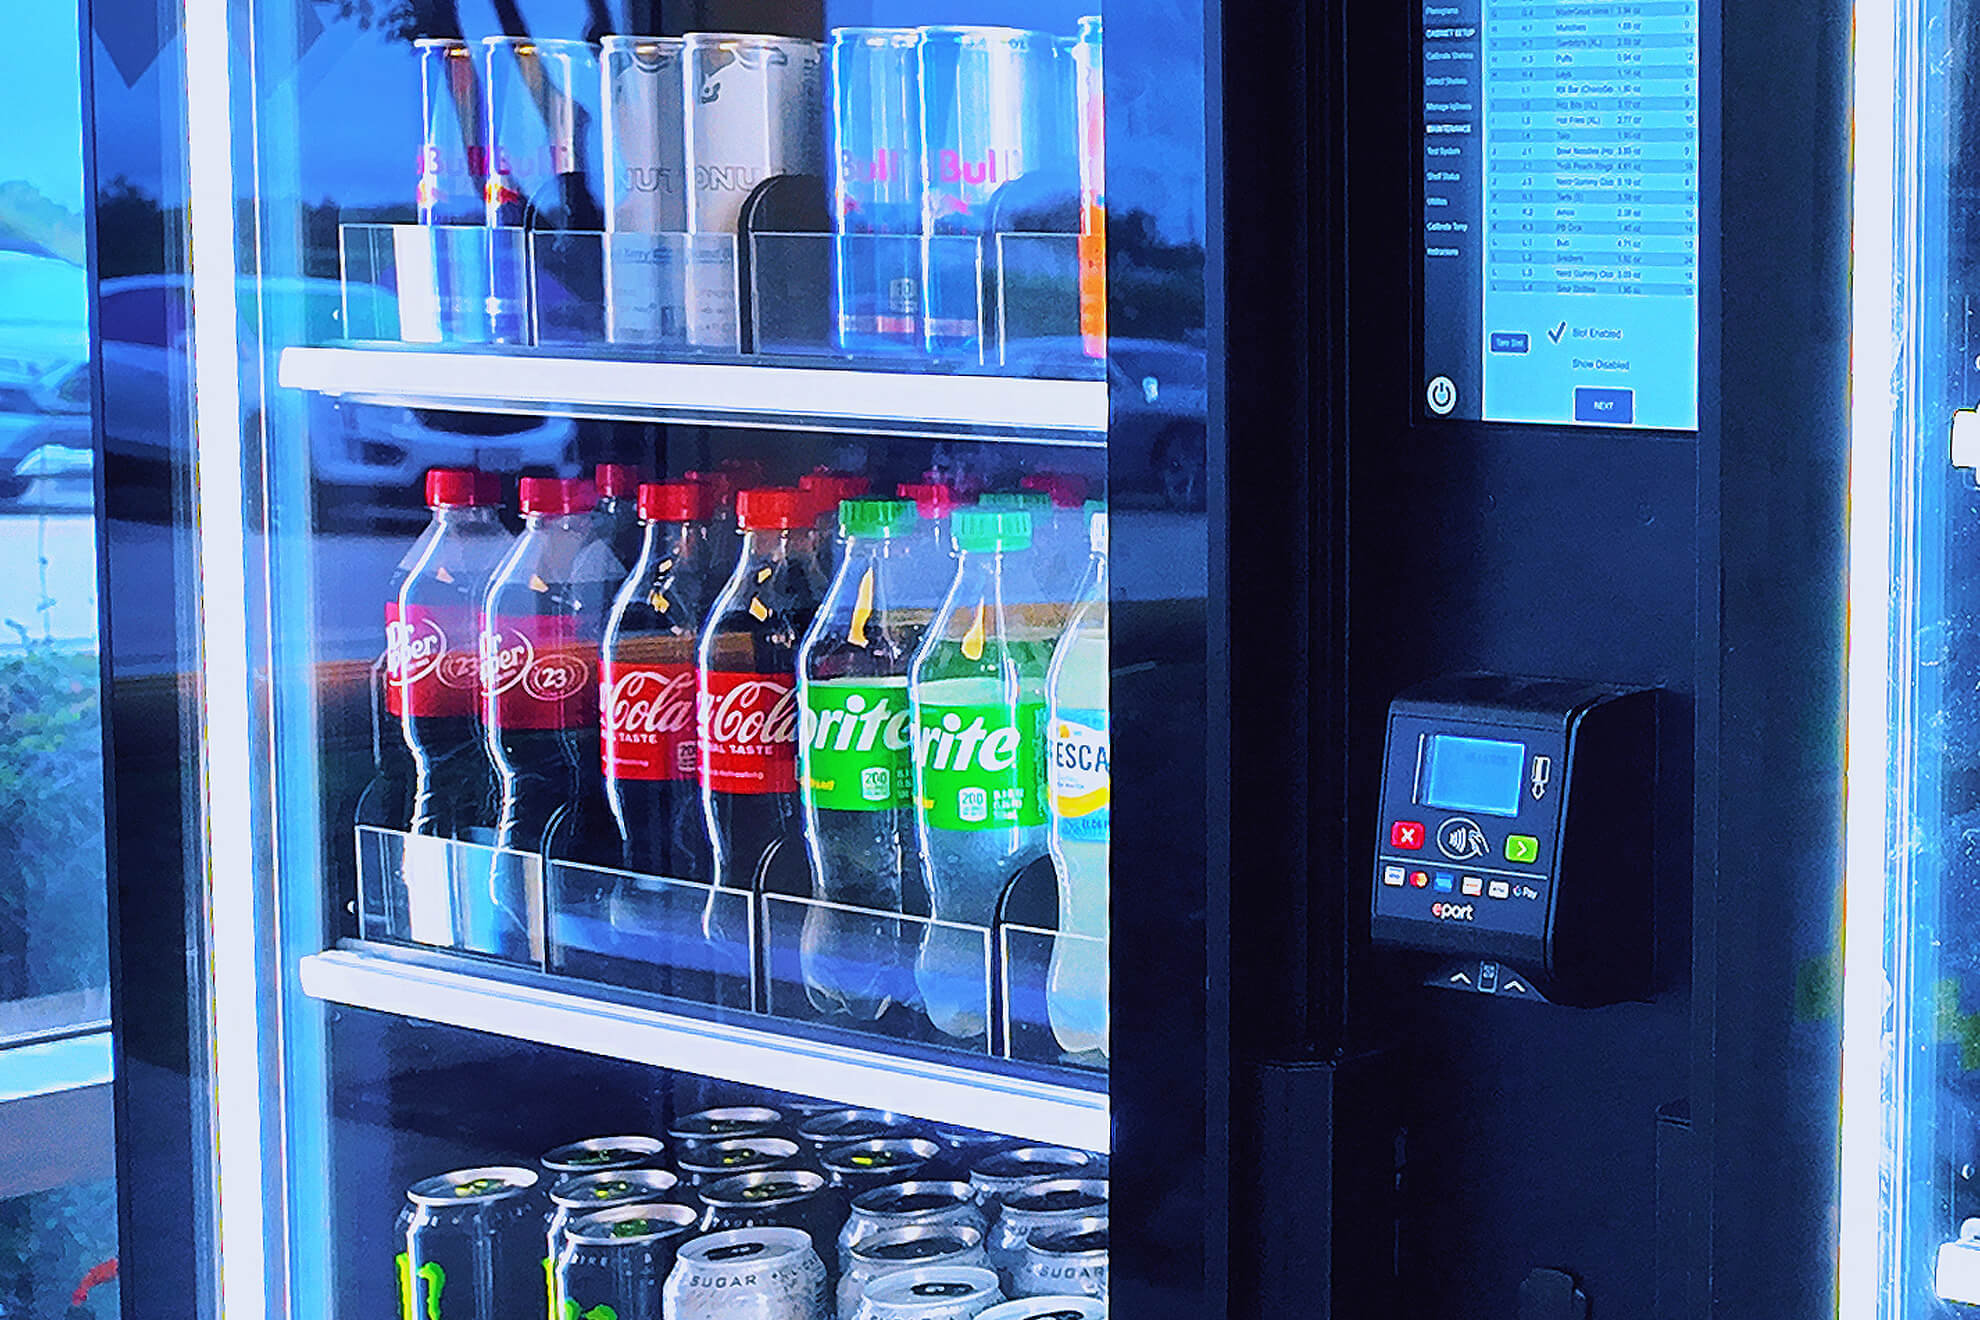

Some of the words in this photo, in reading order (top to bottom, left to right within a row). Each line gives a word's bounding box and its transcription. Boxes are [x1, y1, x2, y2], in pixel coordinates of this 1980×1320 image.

[541, 667, 567, 689] 23
[618, 733, 658, 745] TASTE
[728, 744, 773, 756] TASTE
[1432, 902, 1474, 921] eport
[689, 1274, 757, 1289] SUGAR
